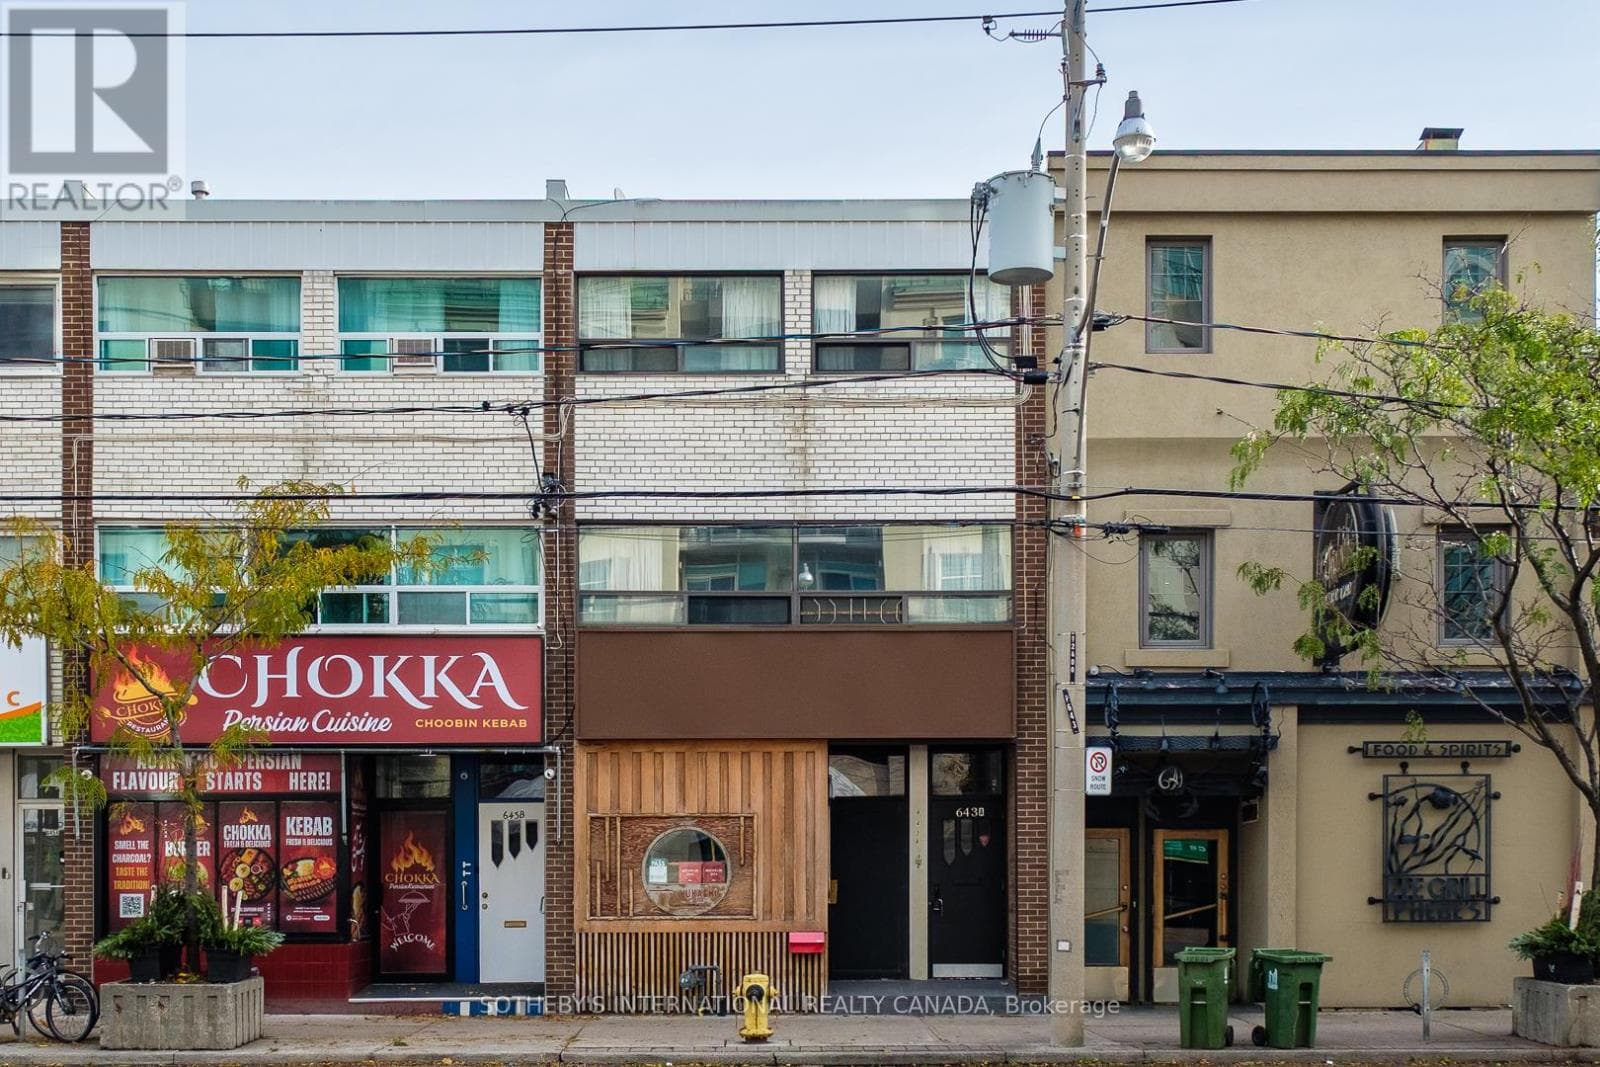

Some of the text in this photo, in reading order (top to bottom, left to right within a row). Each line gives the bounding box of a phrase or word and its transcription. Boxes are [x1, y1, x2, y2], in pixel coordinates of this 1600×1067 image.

[197, 646, 529, 710] CHOKKA
[116, 700, 164, 717] CHOK
[126, 717, 170, 734] RESTAURAN
[223, 709, 393, 733] Persian Cuisine
[415, 718, 528, 728] CHOOBIN KEBAB
[1373, 743, 1502, 756] FOOD & SPIRITS
[112, 771, 331, 791] FLAVOUR STARTS HERE!
[223, 825, 272, 840] CHOKKA
[286, 816, 333, 836] KEBAB
[114, 840, 150, 850] SMELL THE
[385, 872, 441, 884] CHOKKA
[390, 933, 436, 952] WELCOME
